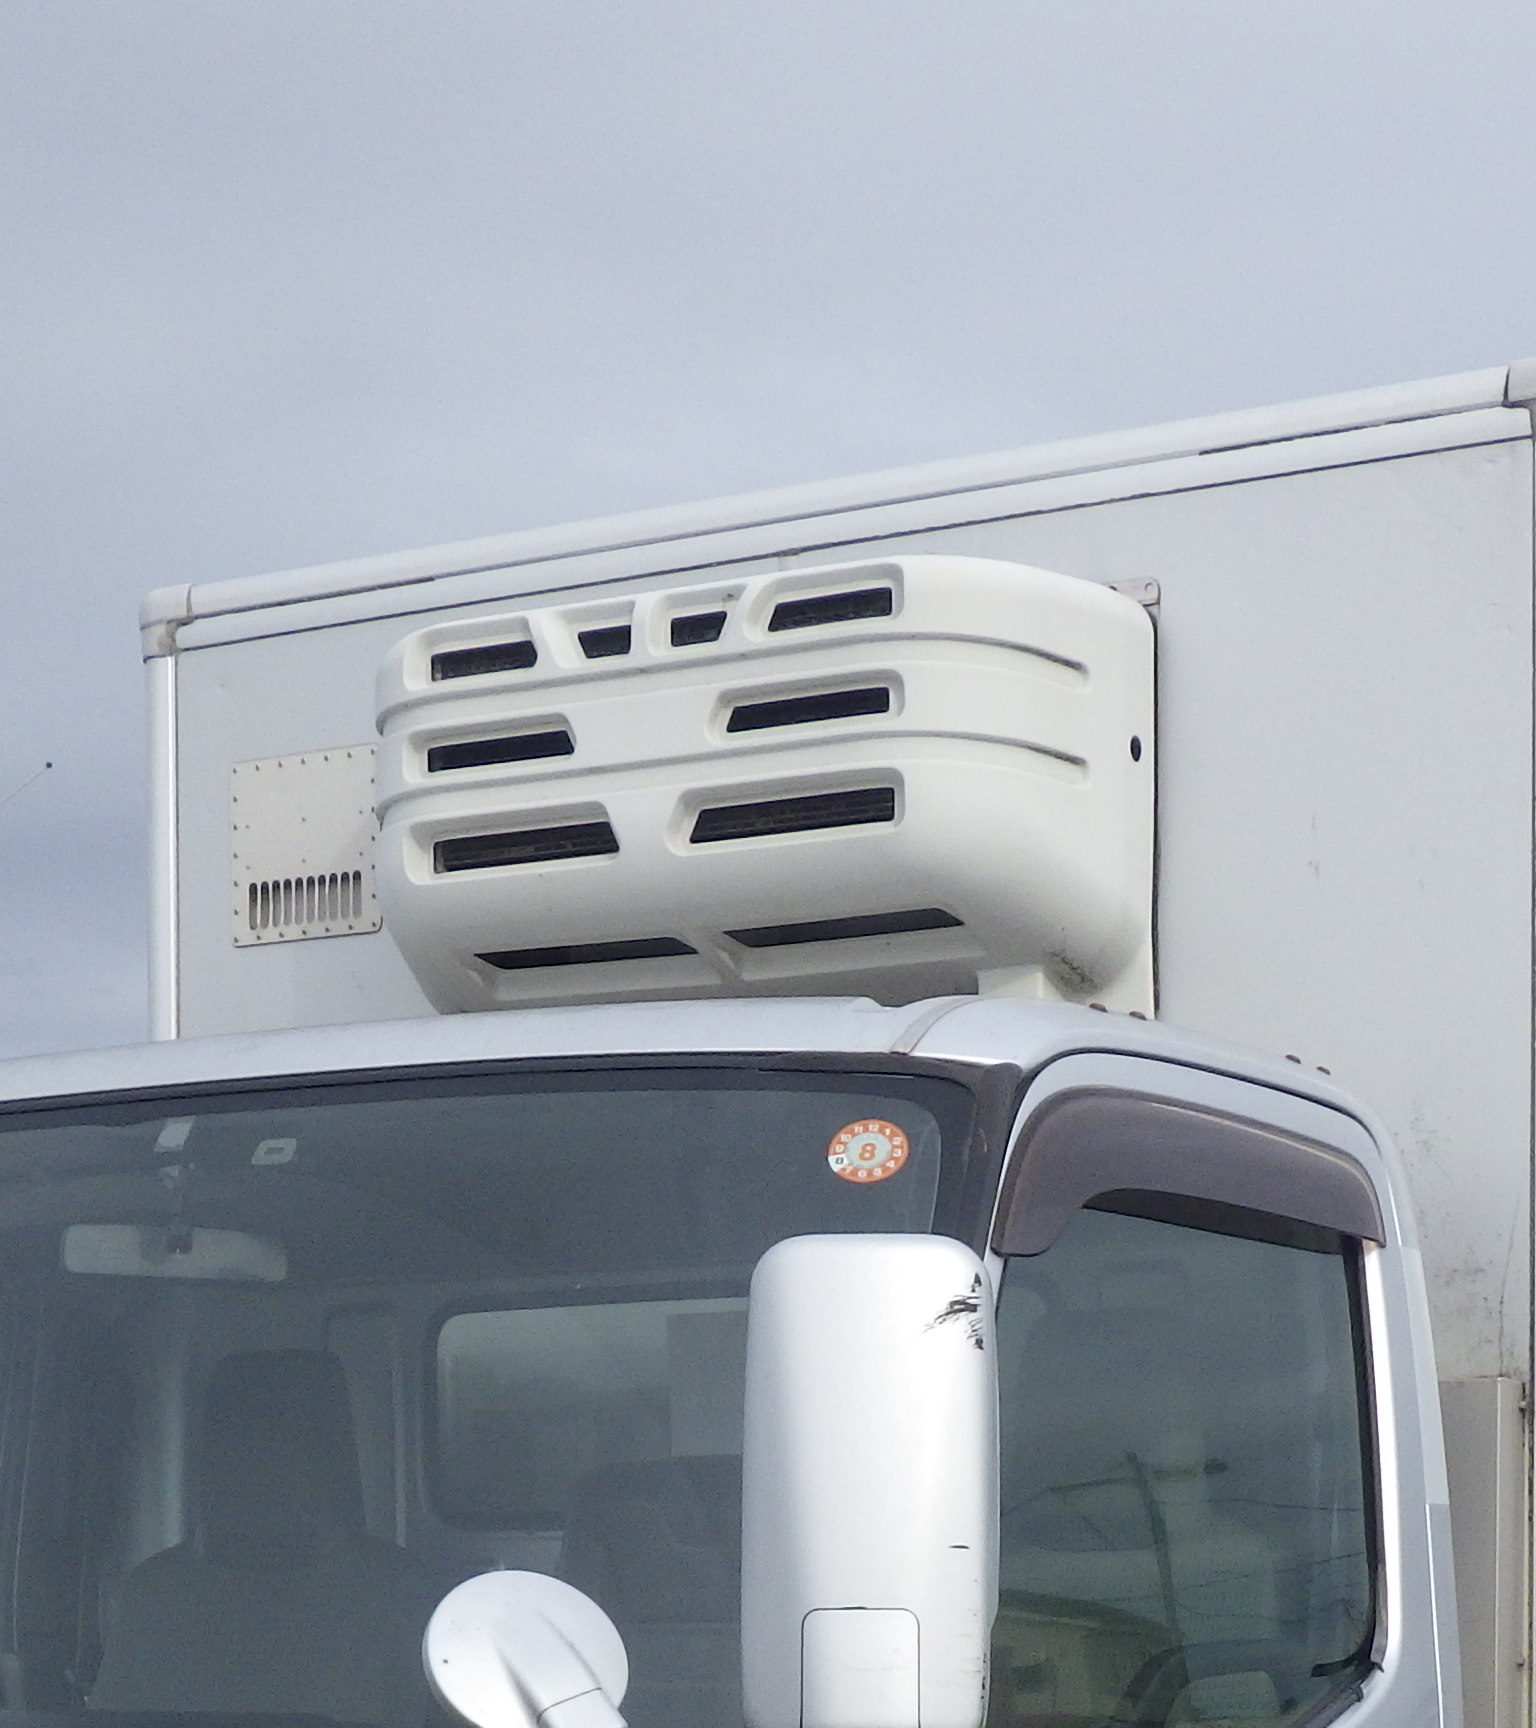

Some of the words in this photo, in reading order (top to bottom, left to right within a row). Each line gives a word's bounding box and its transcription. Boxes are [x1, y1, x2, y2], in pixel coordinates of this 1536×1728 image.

[868, 1124, 880, 1133] 12
[884, 1127, 891, 1136] 1
[840, 1133, 852, 1142] 10
[893, 1137, 903, 1145] 2
[835, 1145, 844, 1153] 9
[858, 1142, 877, 1161] 8
[893, 1149, 902, 1157] 3
[835, 1157, 844, 1165] 8
[886, 1160, 895, 1169] 4
[858, 1170, 867, 1178] 6
